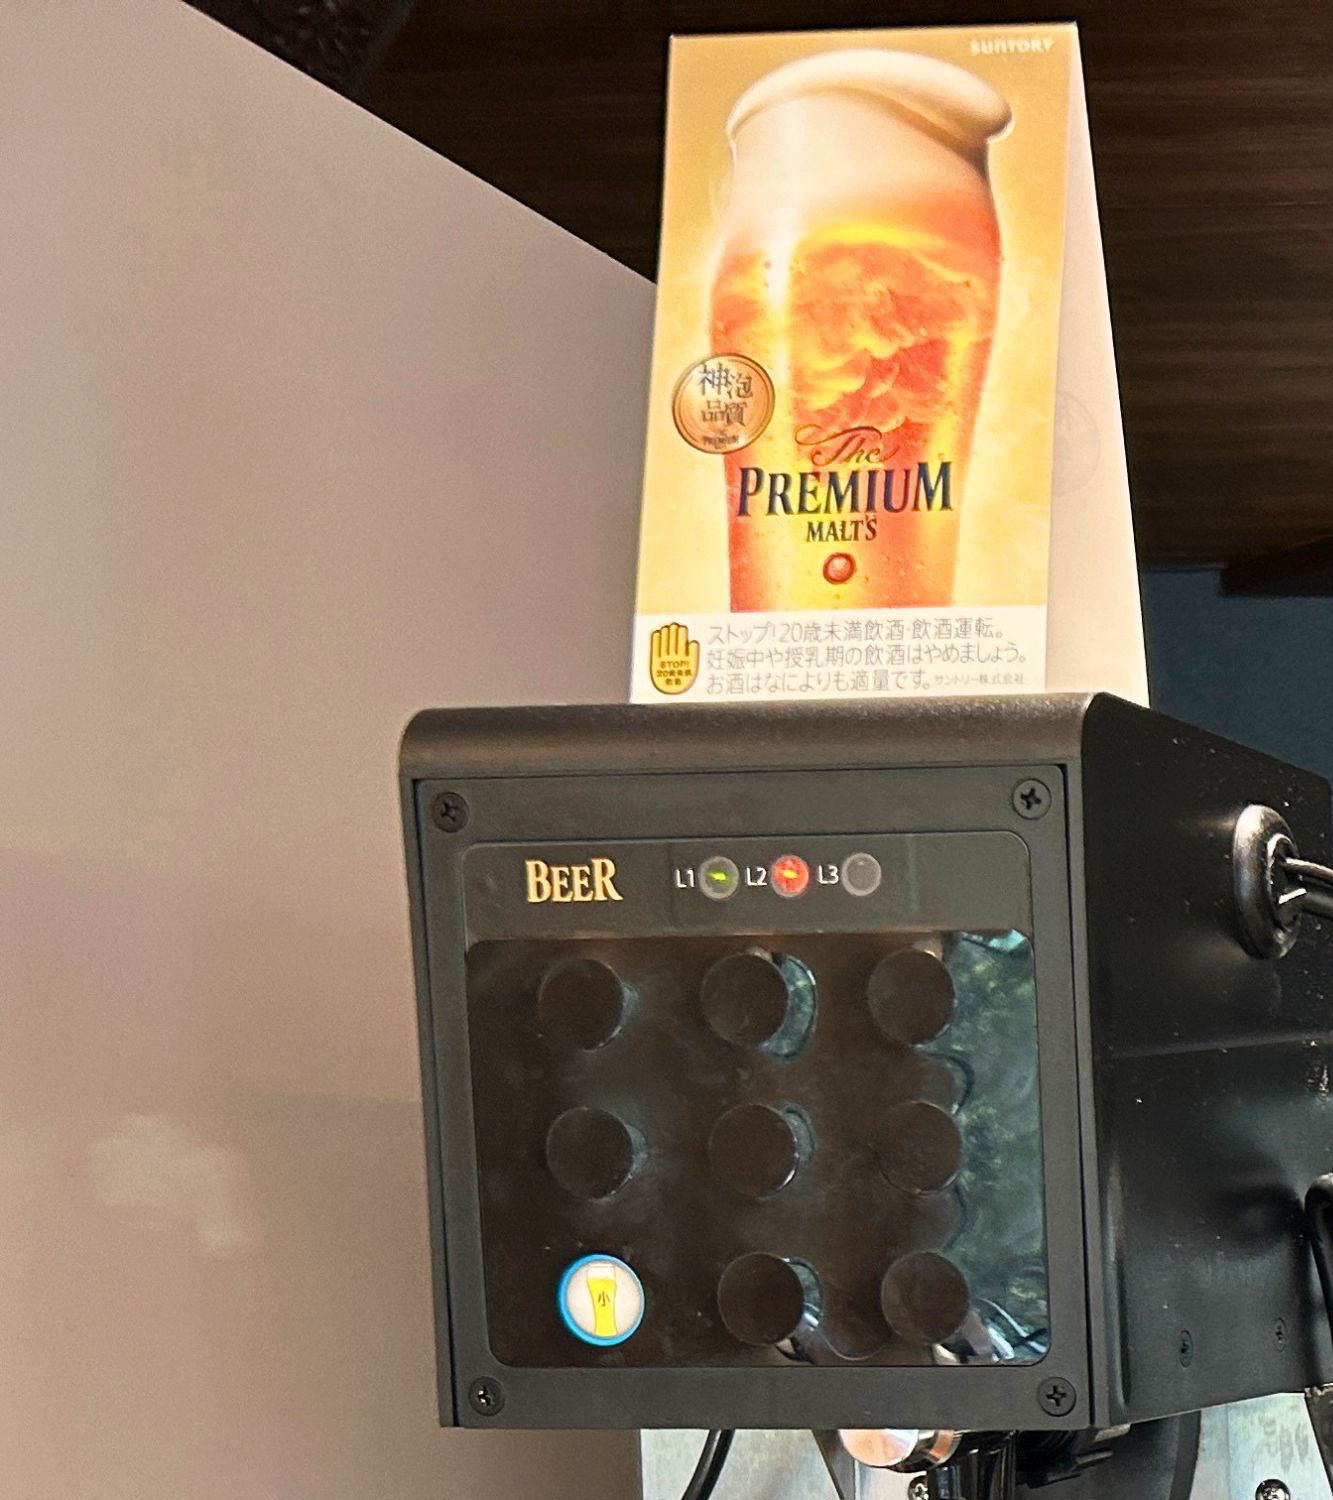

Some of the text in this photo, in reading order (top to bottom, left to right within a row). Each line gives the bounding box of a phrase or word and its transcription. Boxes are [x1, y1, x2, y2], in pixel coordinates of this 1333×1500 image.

[970, 38, 1054, 56] SUNTORY
[698, 361, 753, 399] 神泡
[701, 400, 747, 427] 品質
[795, 425, 900, 467] The
[736, 461, 953, 517] PREMIUM
[805, 516, 877, 543] MALT'S
[706, 641, 1026, 670] 妊娠中や授乳期の飲酒はやめましょう。
[706, 668, 930, 695] お酒はなによりも適量です。
[525, 856, 839, 903] BEER L1 L2 L3
